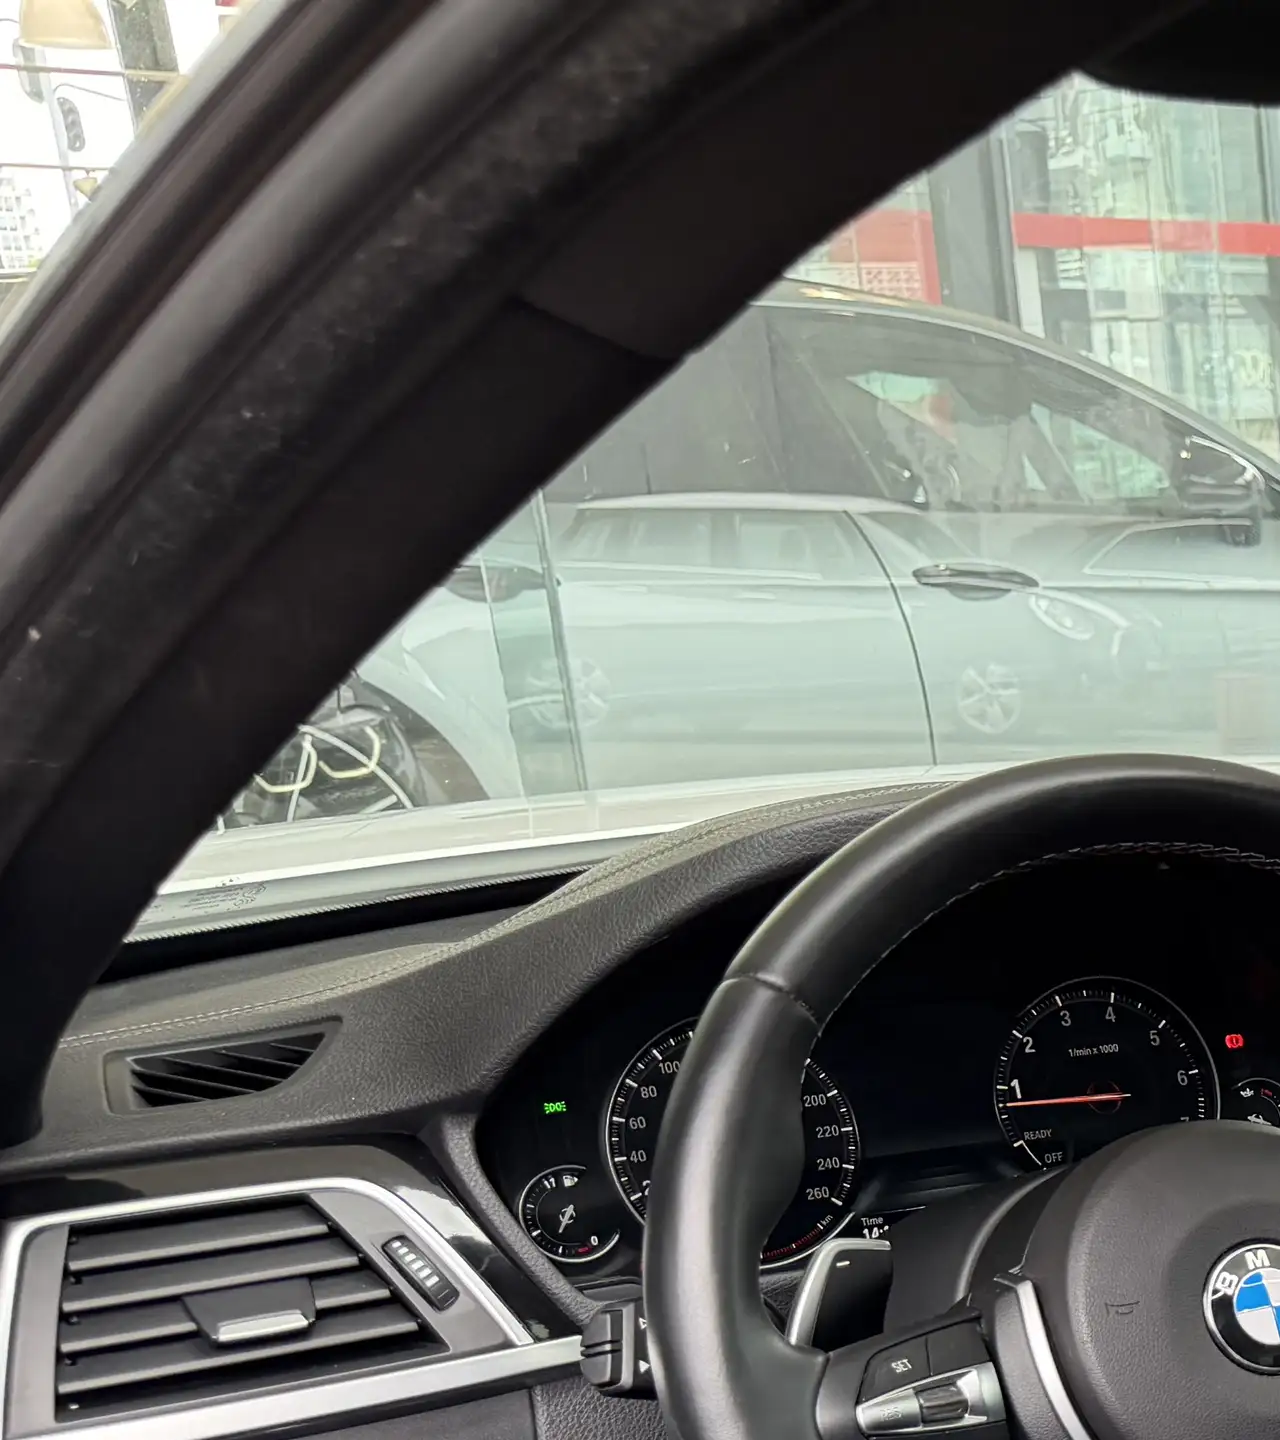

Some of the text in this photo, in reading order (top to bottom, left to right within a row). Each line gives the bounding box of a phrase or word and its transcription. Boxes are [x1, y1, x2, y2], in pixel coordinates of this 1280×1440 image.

[1060, 1010, 1072, 1026] 3
[1105, 1006, 1116, 1022] 4
[1022, 1036, 1036, 1053] 2
[1149, 1030, 1160, 1046] 5
[1099, 1043, 1119, 1054] 1000
[658, 1060, 681, 1076] 100
[1177, 1070, 1188, 1086] 6
[640, 1085, 658, 1099] 80
[1010, 1079, 1022, 1099] 1
[803, 1093, 827, 1108] 200
[629, 1116, 647, 1130] 60
[815, 1124, 839, 1139] 220
[1023, 1128, 1052, 1141] READY
[630, 1150, 647, 1164] 40
[816, 1156, 840, 1171] 240
[1044, 1152, 1064, 1164] OFF
[805, 1186, 830, 1201] 260
[860, 1217, 884, 1226] Time
[891, 1358, 913, 1373] SET
